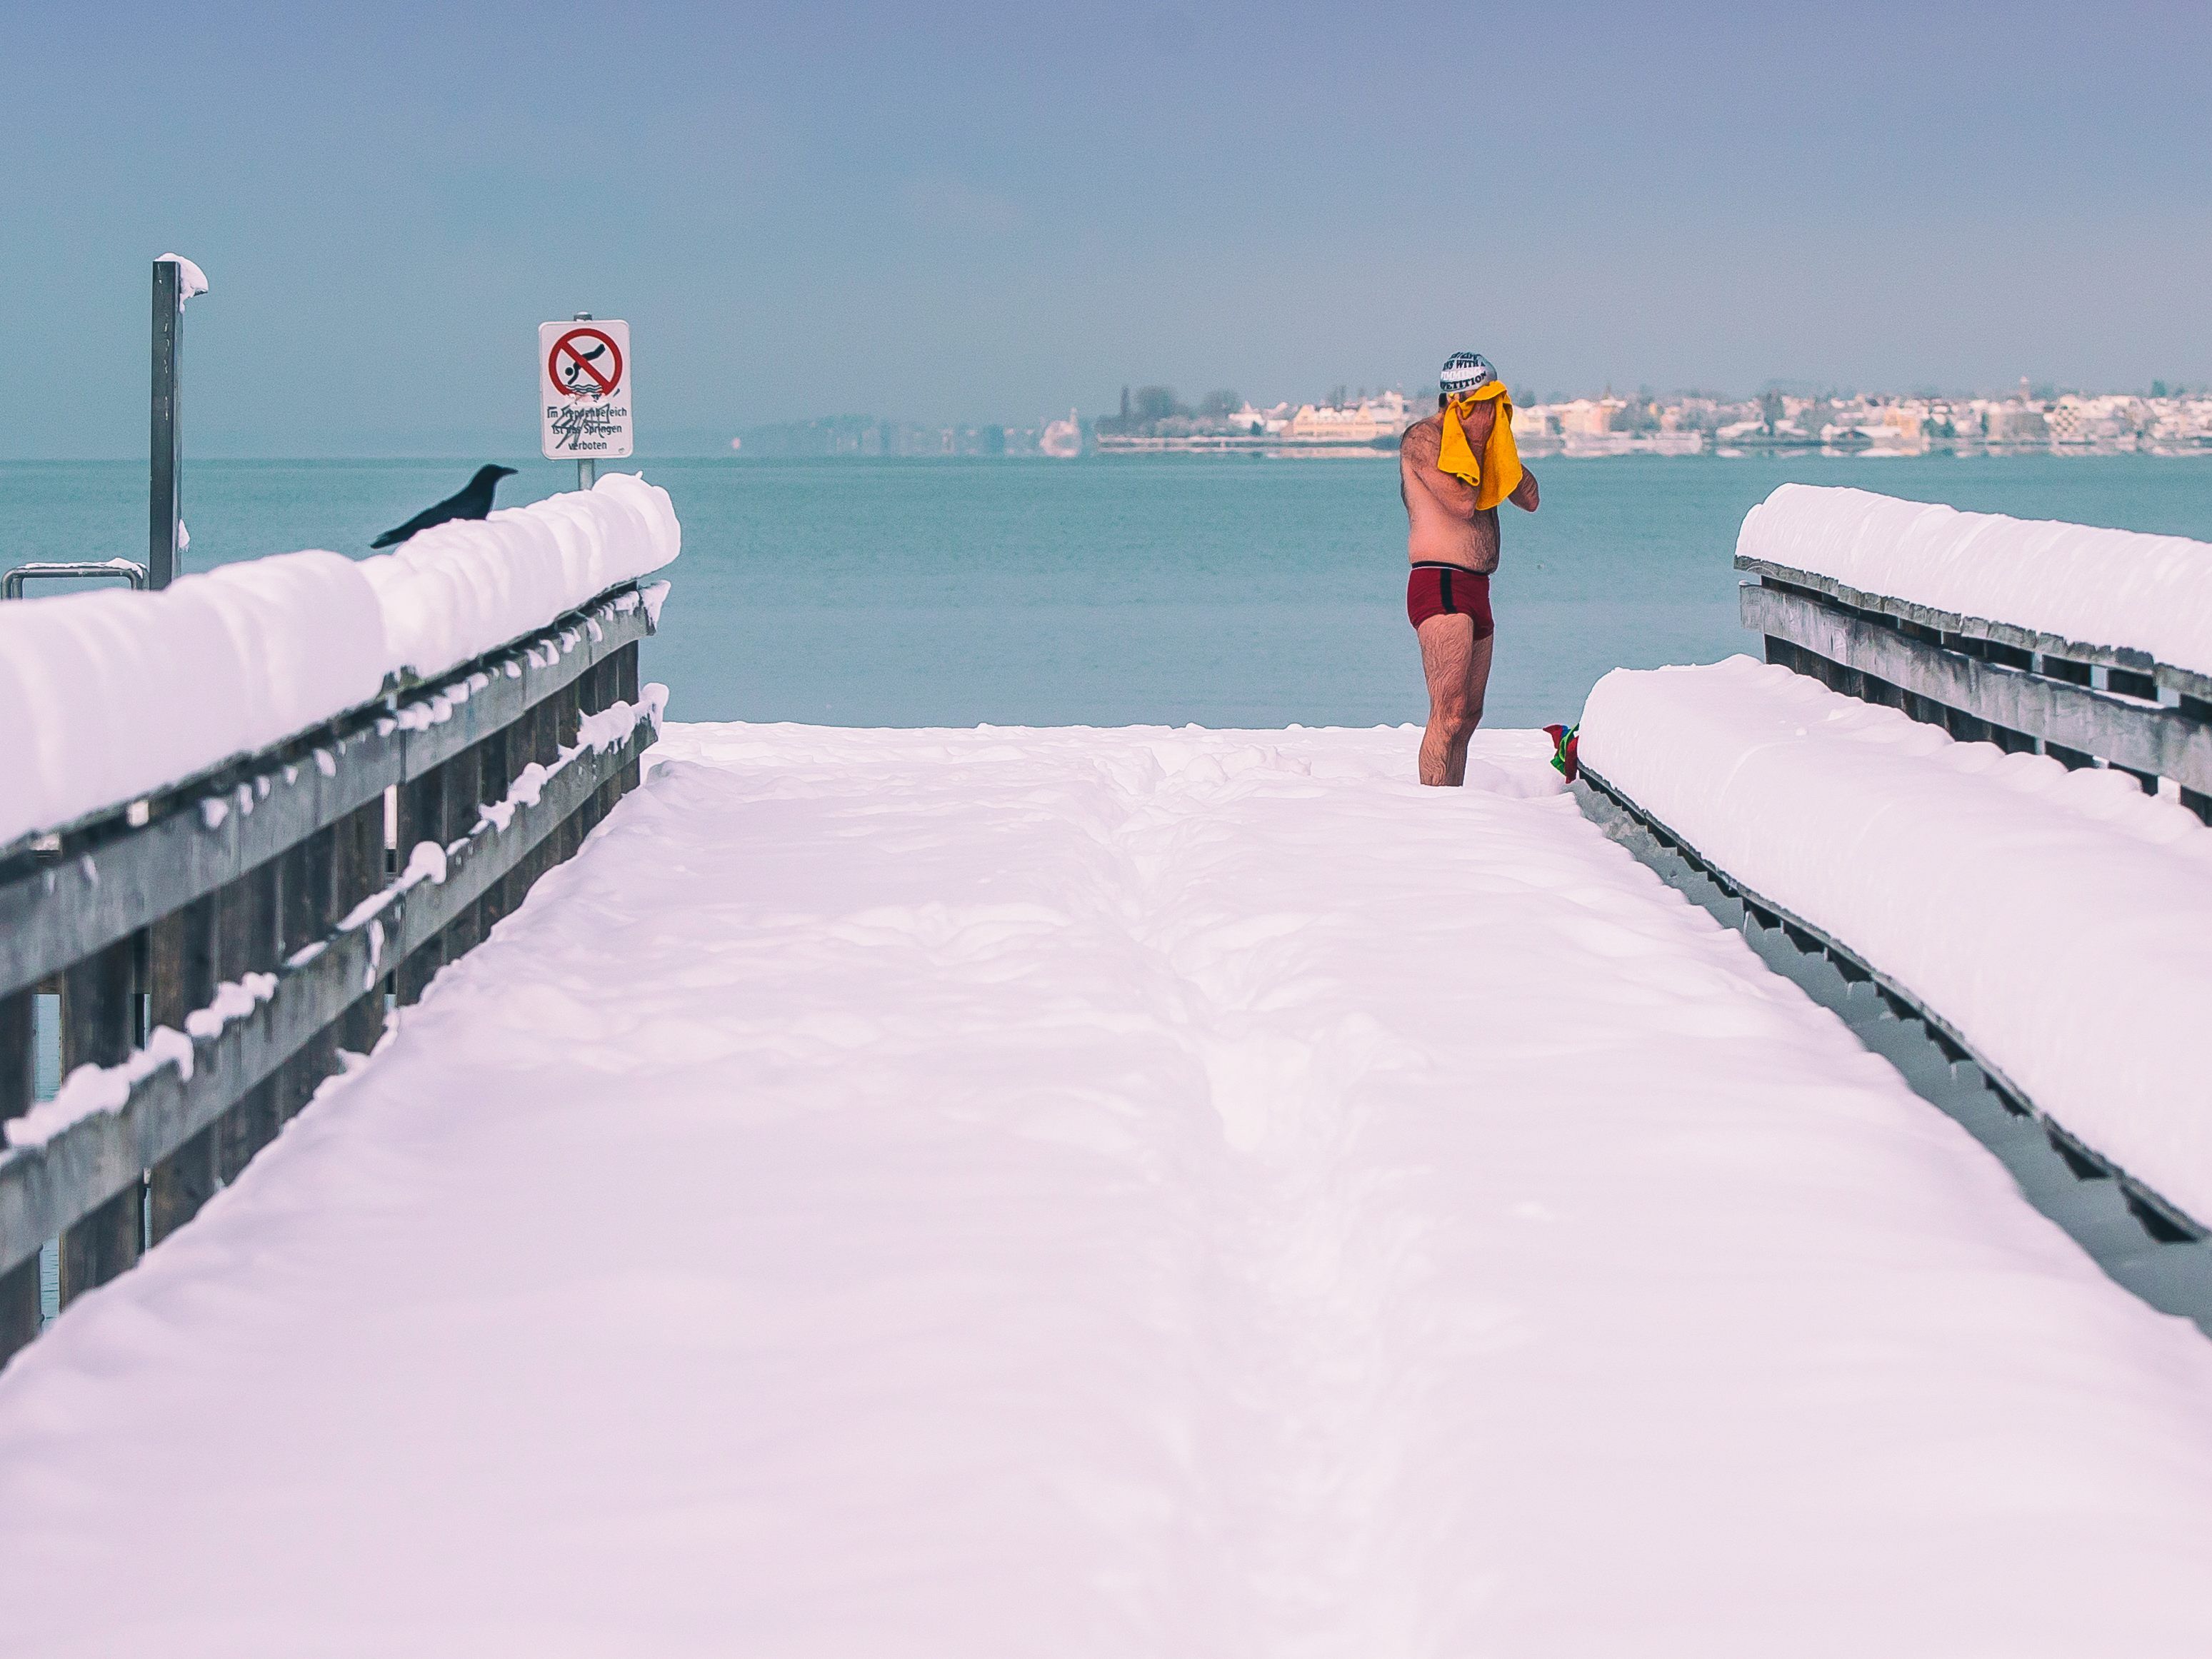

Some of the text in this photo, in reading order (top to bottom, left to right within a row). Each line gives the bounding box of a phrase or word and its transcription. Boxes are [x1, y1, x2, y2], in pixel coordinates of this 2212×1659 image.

[1456, 360, 1478, 369] WITH
[547, 406, 627, 419] Im repenbeeich
[584, 424, 622, 436] Springen
[568, 441, 607, 450] verboten
